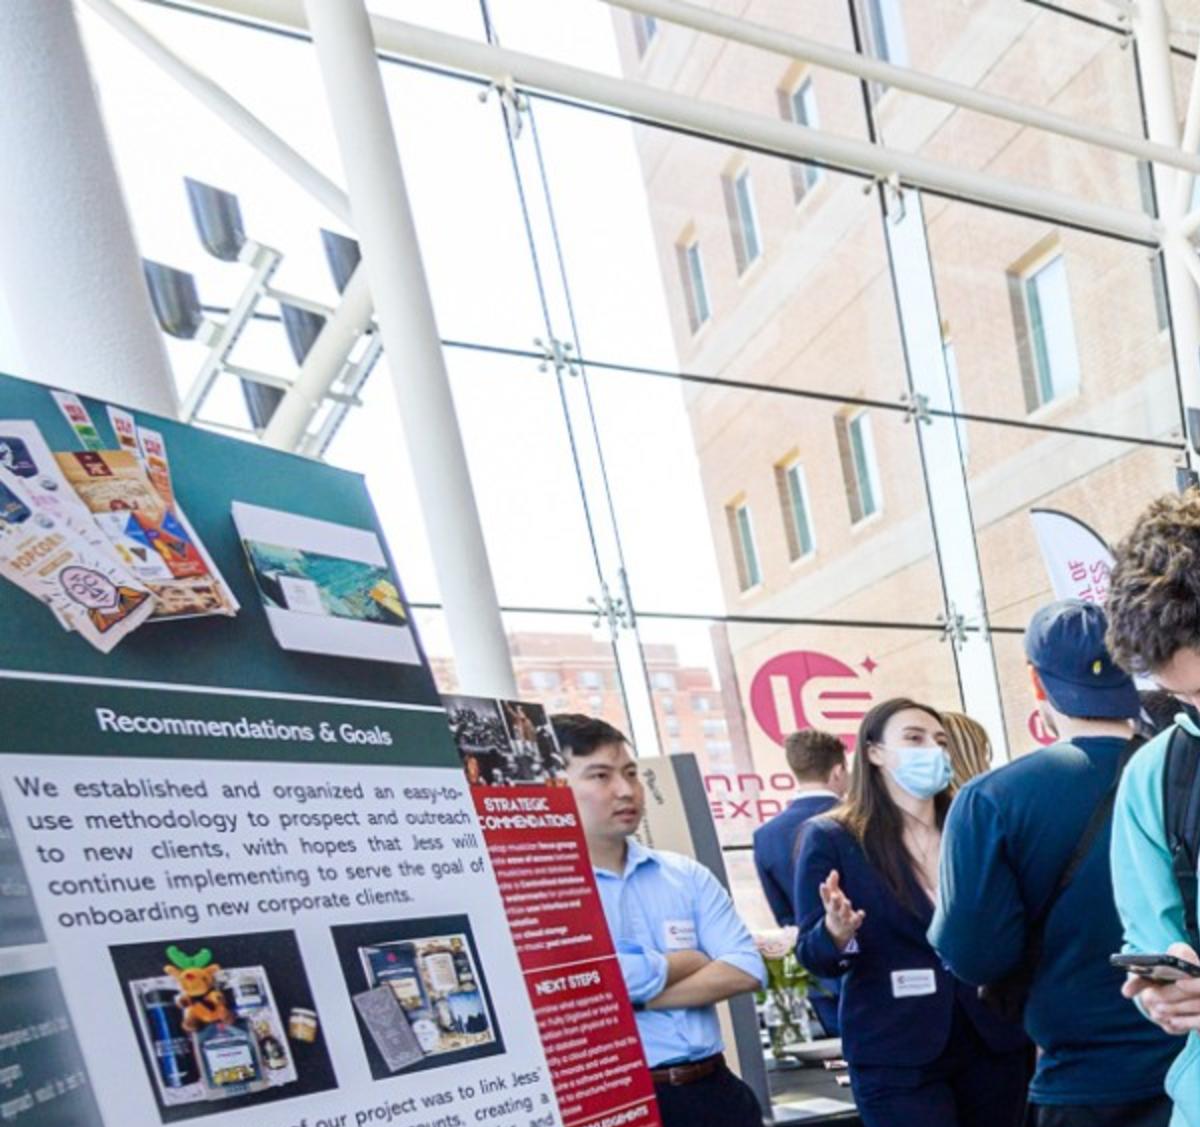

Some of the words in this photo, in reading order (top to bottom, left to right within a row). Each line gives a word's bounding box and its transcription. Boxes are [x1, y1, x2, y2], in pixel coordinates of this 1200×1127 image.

[96, 707, 314, 742] Recommendations
[320, 721, 337, 743] &
[339, 723, 393, 746] Goals
[14, 776, 59, 798] We
[74, 778, 208, 798] established
[222, 781, 260, 799] and
[273, 781, 364, 803] organized
[374, 786, 394, 800] an
[403, 785, 463, 804] easy-to-
[483, 797, 549, 812] STRATEGIC
[27, 814, 73, 831] use
[85, 810, 237, 833] methodology
[247, 811, 270, 827] to
[279, 811, 361, 830] prospect
[367, 810, 398, 826] and
[405, 810, 471, 825] outreach
[478, 813, 577, 831] COMMENDATIONS
[36, 846, 65, 863] to
[83, 845, 134, 861] new
[151, 840, 230, 860] clients,
[243, 838, 288, 857] with
[300, 837, 357, 857] hopes
[367, 836, 402, 852] that
[412, 835, 444, 851] Jess
[452, 833, 479, 849] will
[48, 874, 156, 896] continue
[166, 867, 310, 893] implementing
[317, 864, 338, 881] to
[346, 864, 392, 880] serve
[398, 859, 426, 877] the
[431, 857, 464, 880] goal
[470, 857, 485, 873] of
[57, 901, 199, 928] onboarding
[206, 900, 249, 918] new
[257, 891, 350, 916] corporate
[355, 888, 415, 906] clients.
[534, 976, 567, 996] NEXT
[568, 970, 602, 992] STEPS
[355, 1098, 417, 1126] project
[421, 1090, 454, 1109] was
[457, 1086, 475, 1100] to
[479, 1074, 508, 1095] link
[512, 1067, 542, 1088] Jess'
[474, 1096, 534, 1121] creating
[540, 1092, 549, 1104] a
